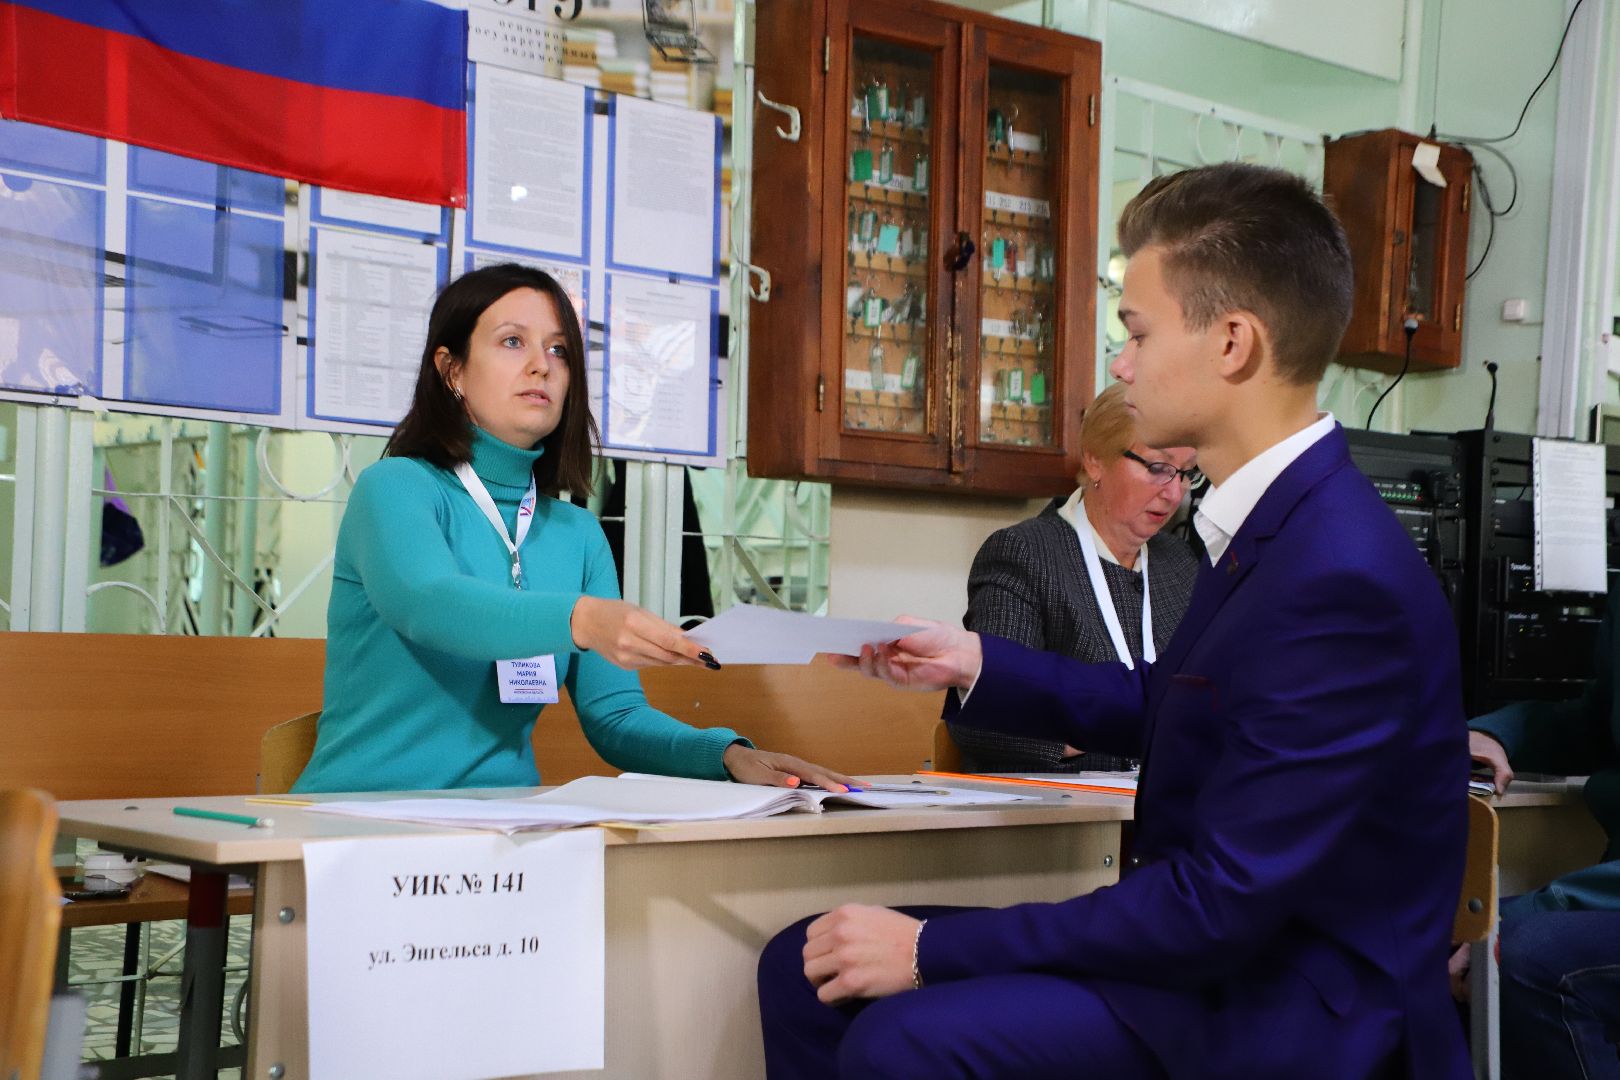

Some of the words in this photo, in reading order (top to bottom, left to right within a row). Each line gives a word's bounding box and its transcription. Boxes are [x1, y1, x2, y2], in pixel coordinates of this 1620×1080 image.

[392, 874, 450, 897] УИК
[456, 873, 482, 894] №
[492, 872, 525, 893] 141
[368, 950, 396, 970] ул.
[403, 943, 491, 962] Энгельса
[497, 942, 513, 958] д.
[520, 936, 539, 954] 10
